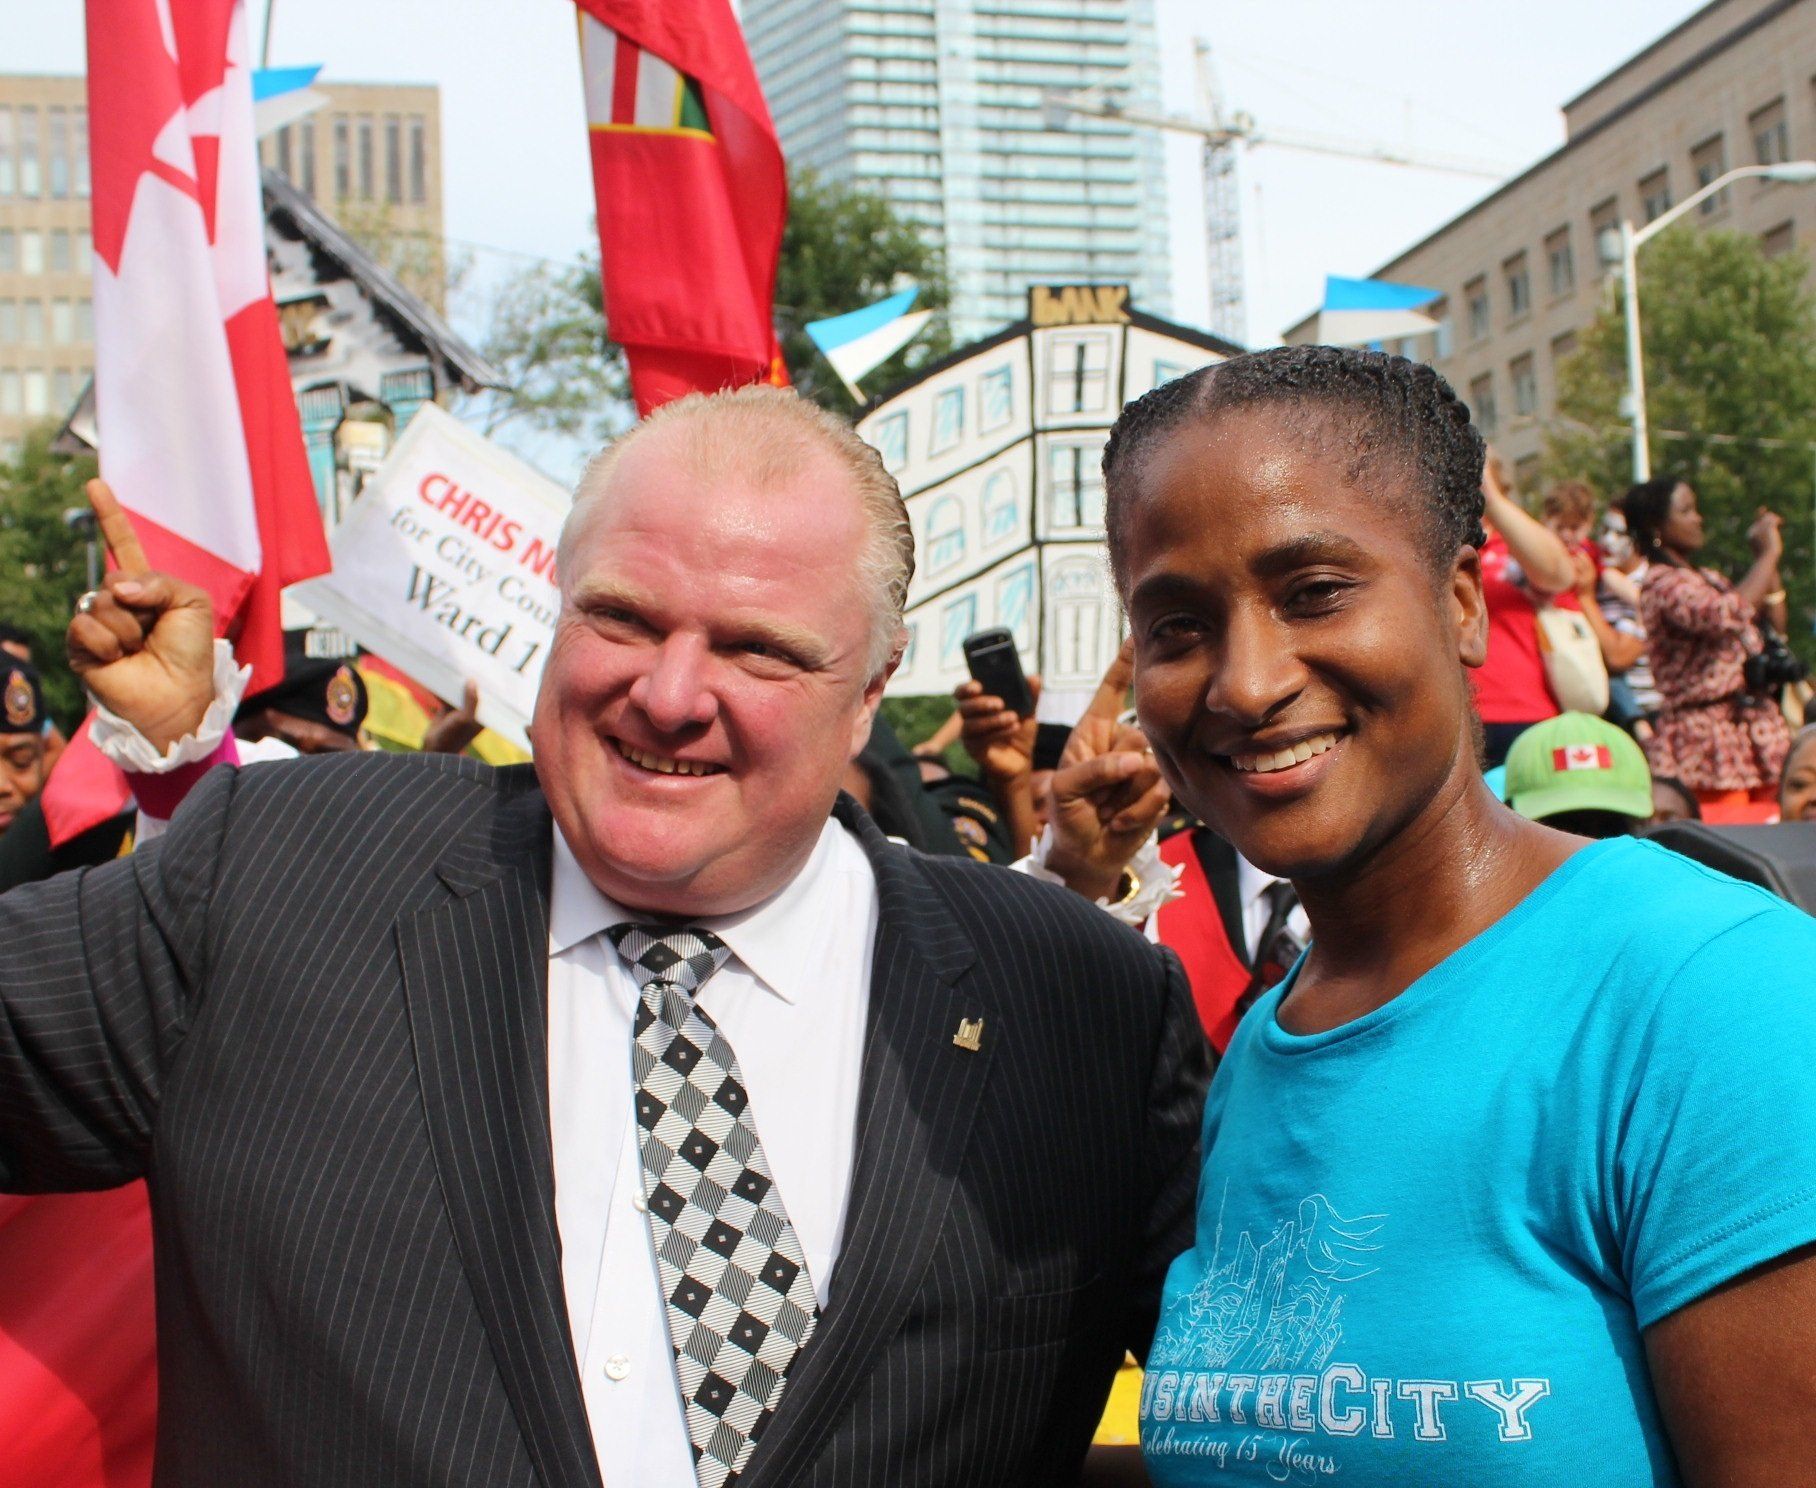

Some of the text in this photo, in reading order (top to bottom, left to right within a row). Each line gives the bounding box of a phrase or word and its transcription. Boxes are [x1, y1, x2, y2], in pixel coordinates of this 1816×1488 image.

[389, 506, 431, 544] for
[437, 534, 492, 586] City
[418, 472, 523, 551] CHRIS
[406, 563, 513, 656] Ward
[1236, 1434, 1263, 1461] 15
[1264, 1432, 1342, 1486] Years
